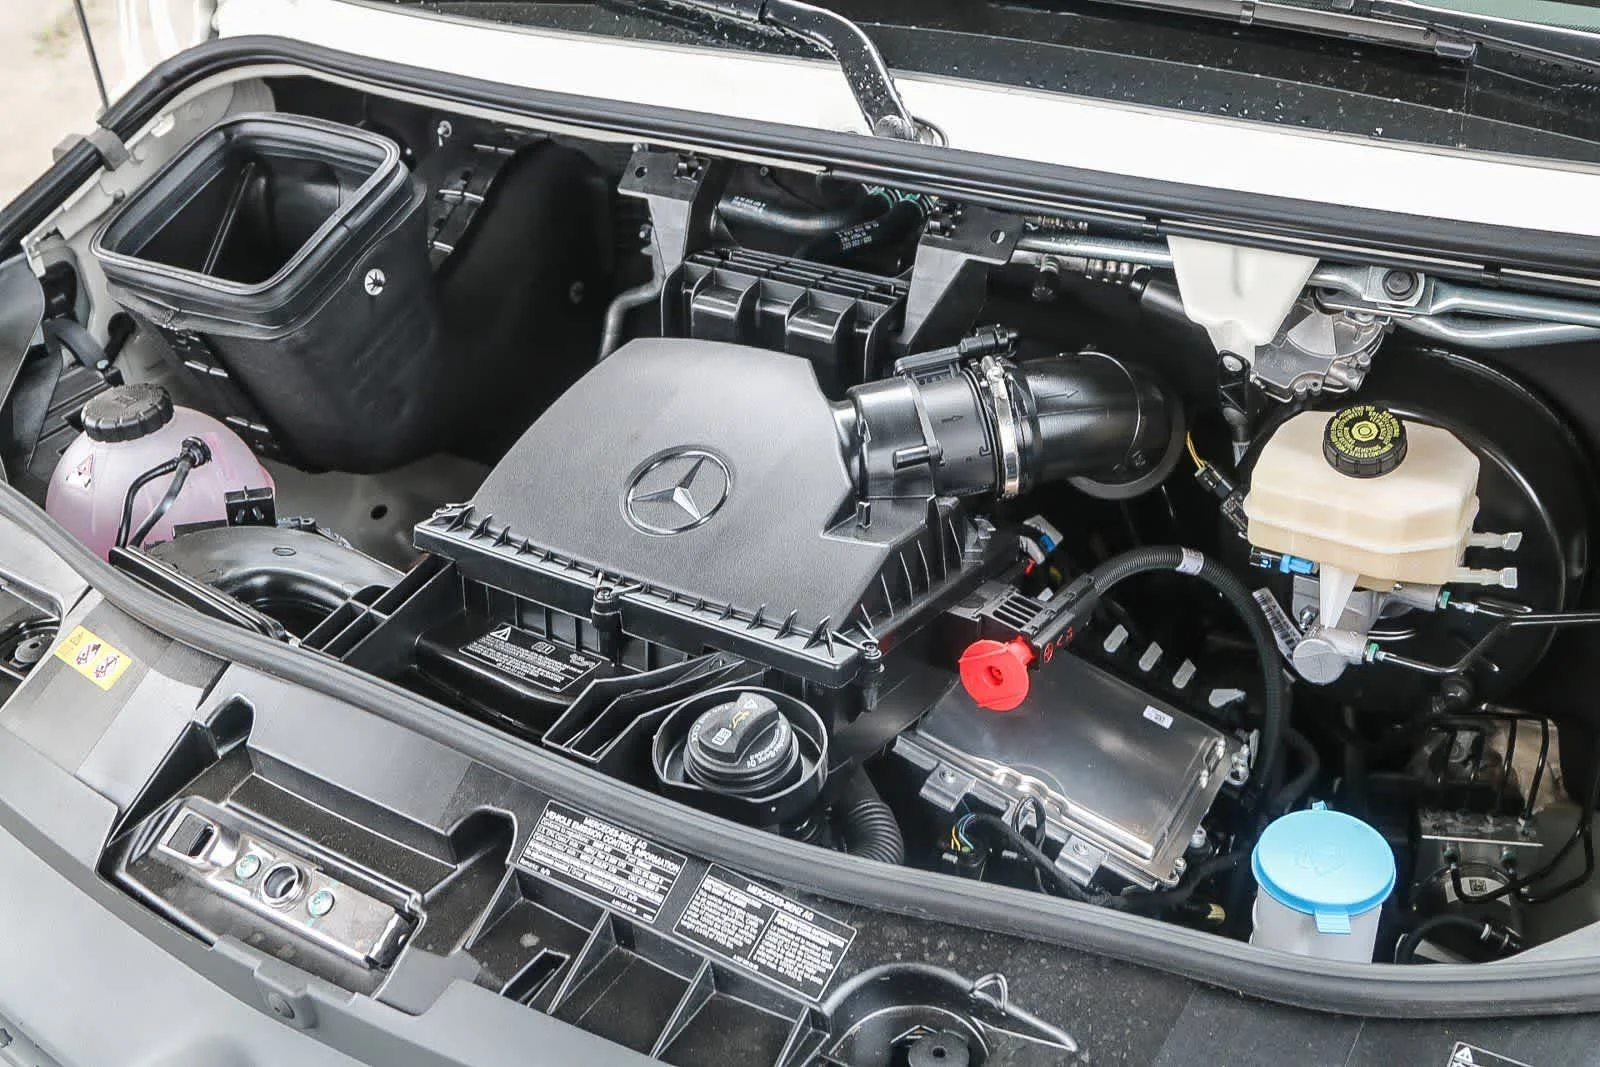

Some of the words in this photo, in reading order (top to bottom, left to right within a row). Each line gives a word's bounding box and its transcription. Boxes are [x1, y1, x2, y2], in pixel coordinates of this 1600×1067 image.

[543, 809, 572, 826] VEHICLE
[570, 820, 603, 839] EMISSION
[602, 834, 634, 853] CONTROL
[632, 847, 680, 873] INFORMATION
